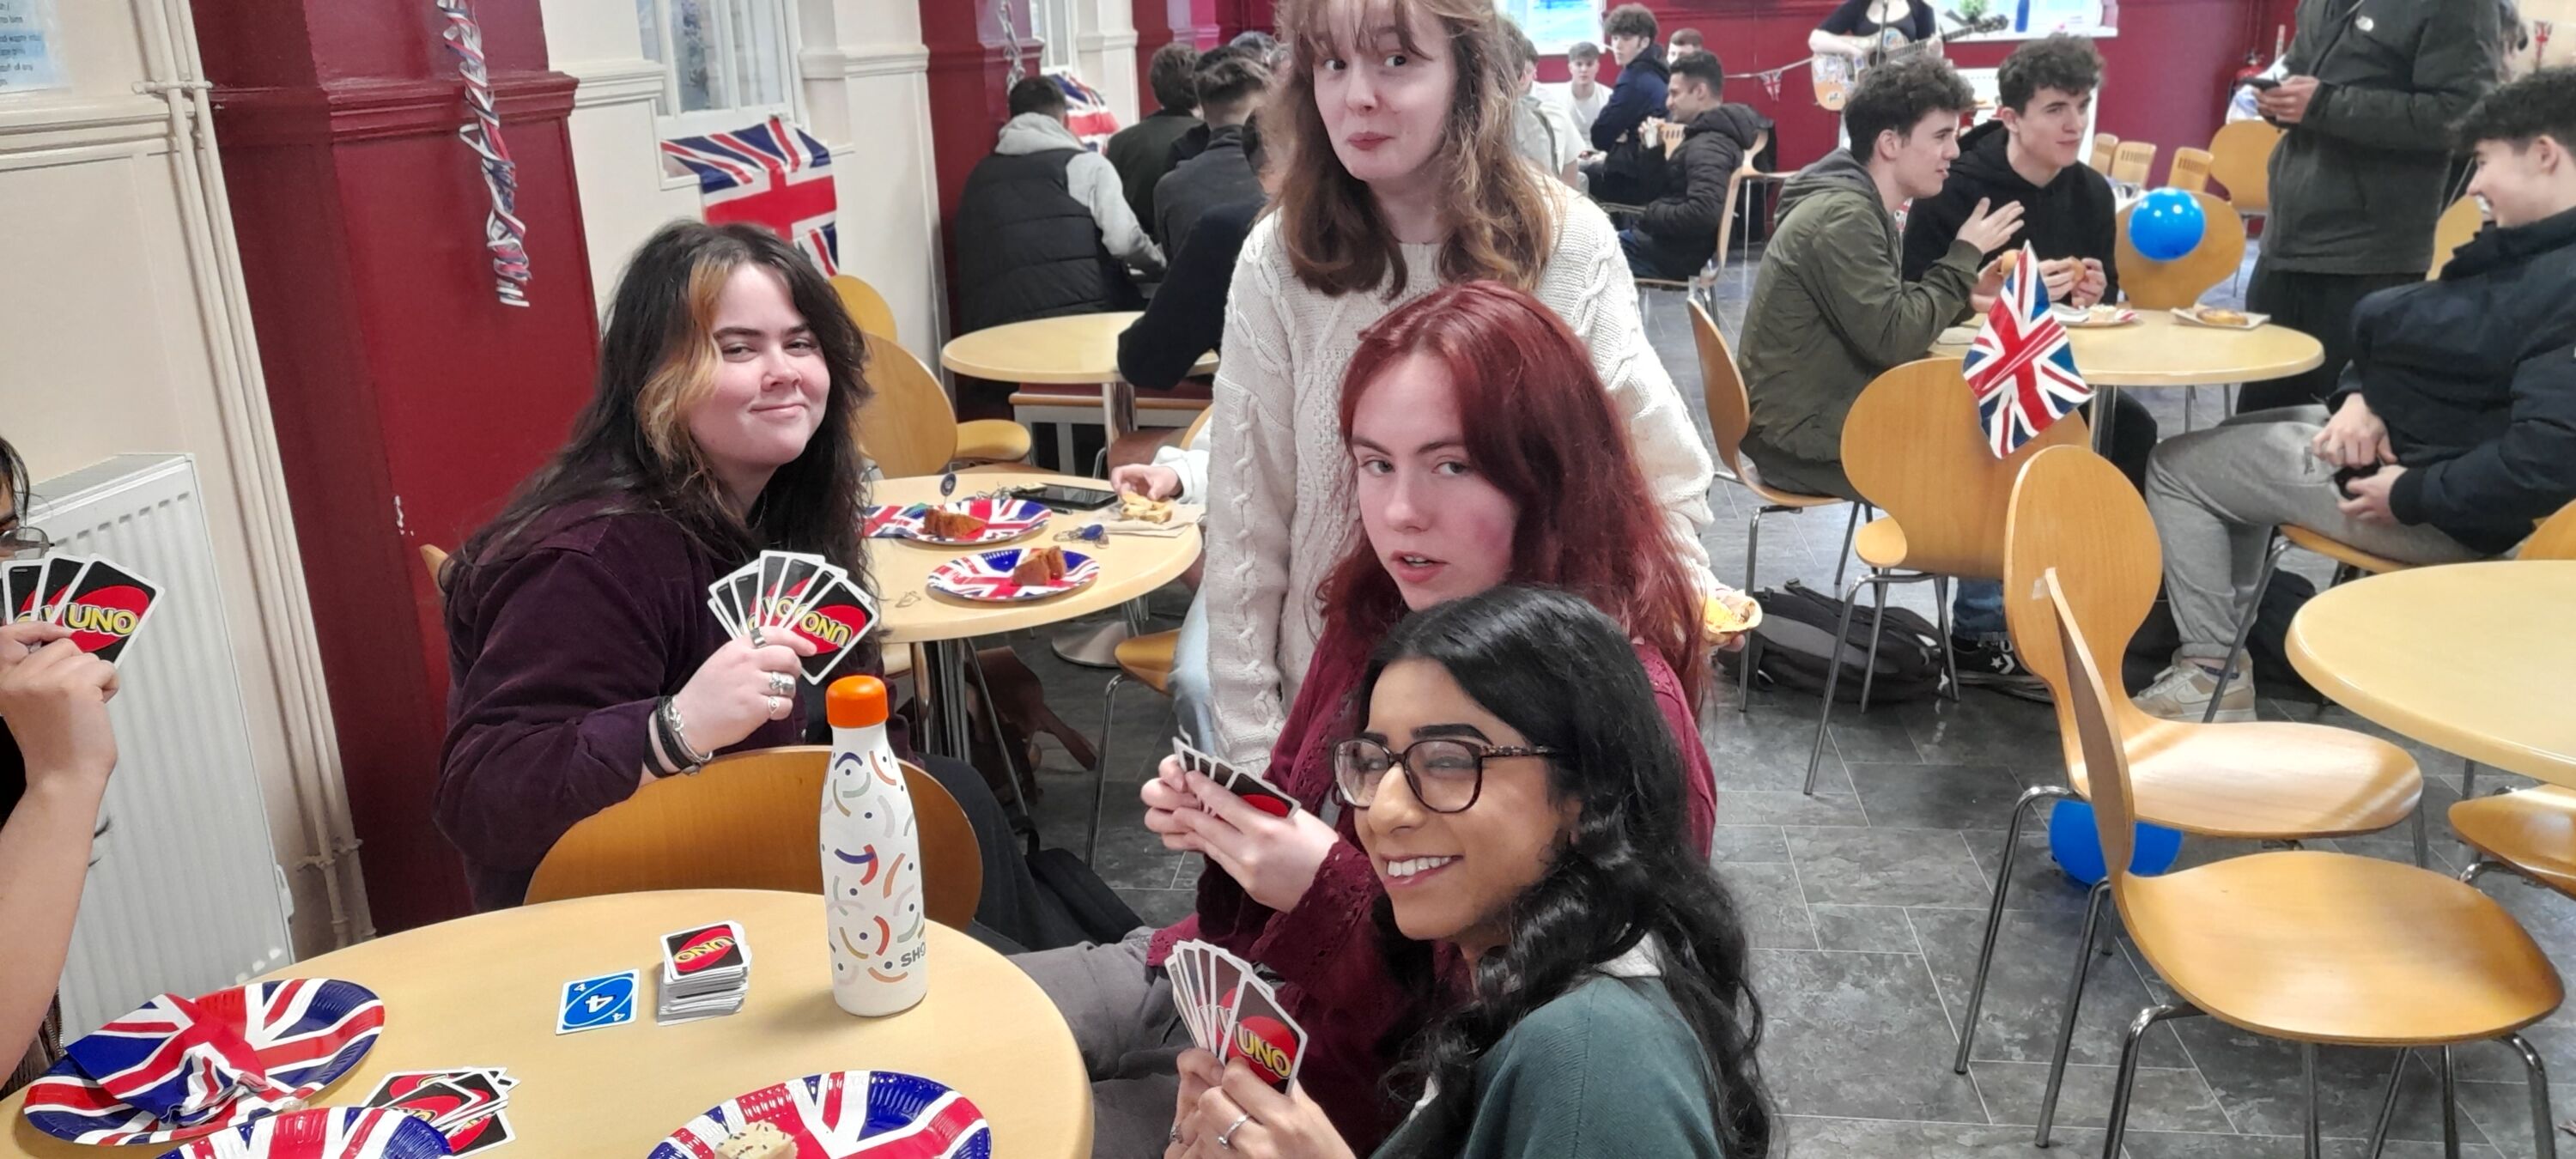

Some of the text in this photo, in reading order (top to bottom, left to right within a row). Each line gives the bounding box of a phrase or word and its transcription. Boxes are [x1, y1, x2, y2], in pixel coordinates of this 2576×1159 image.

[65, 603, 138, 636] UNO
[800, 611, 853, 648] UNO
[674, 936, 736, 963] UNO
[900, 941, 926, 968] SHO
[574, 982, 587, 992] 4
[586, 993, 617, 1013] 4
[612, 1012, 626, 1022] 4
[1235, 1022, 1292, 1079] UNO
